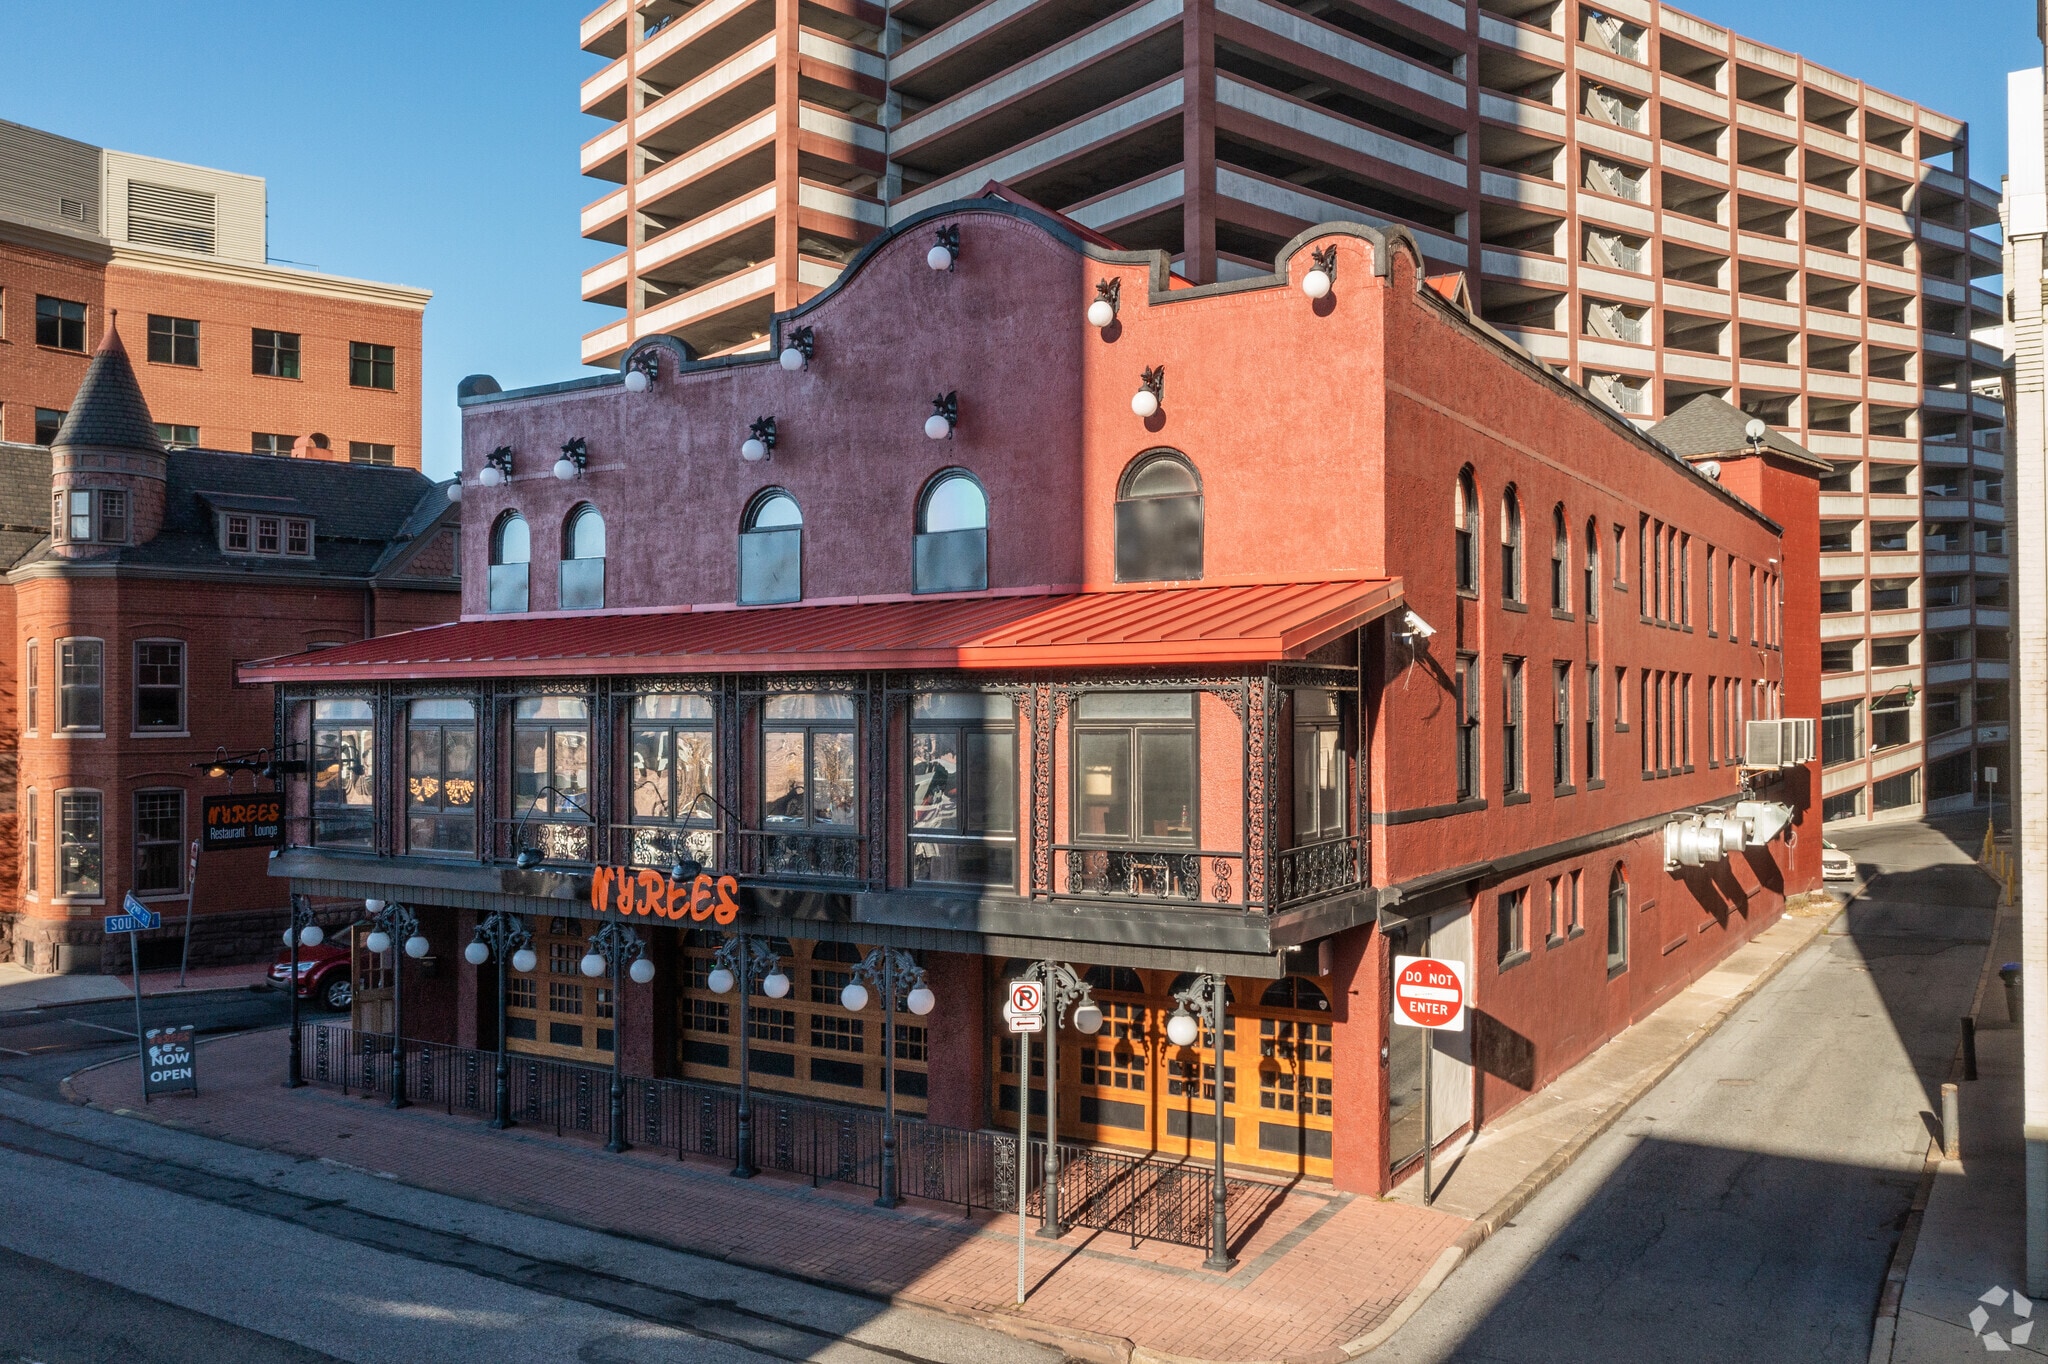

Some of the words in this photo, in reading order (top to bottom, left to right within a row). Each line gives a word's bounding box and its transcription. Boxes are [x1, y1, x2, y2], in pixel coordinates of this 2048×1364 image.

[208, 803, 280, 825] NYREES
[210, 825, 246, 840] Restaurant
[254, 824, 278, 838] Lounge
[591, 866, 739, 925] NYREES
[1406, 971, 1422, 983] DO
[1429, 973, 1453, 986] NOT
[1409, 1001, 1448, 1015] ENTER
[151, 1052, 190, 1067] NOW
[150, 1067, 192, 1083] OPEN
